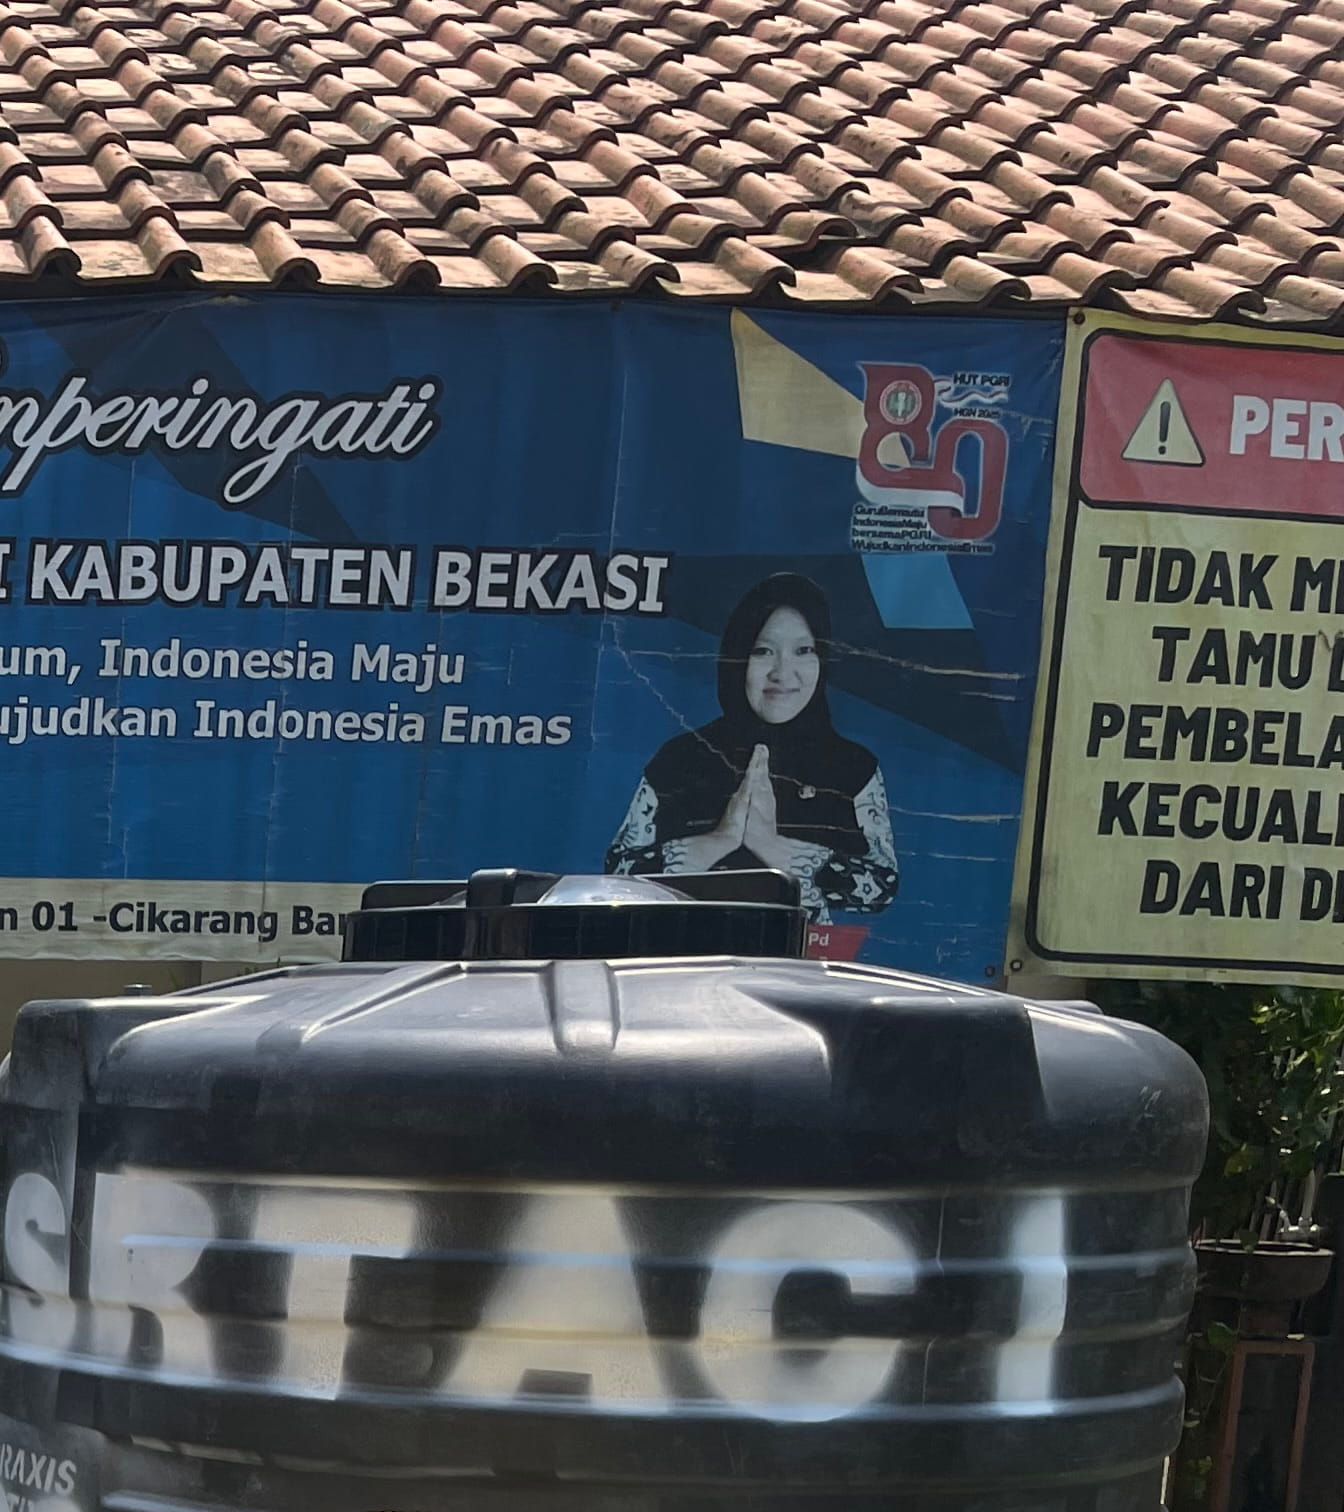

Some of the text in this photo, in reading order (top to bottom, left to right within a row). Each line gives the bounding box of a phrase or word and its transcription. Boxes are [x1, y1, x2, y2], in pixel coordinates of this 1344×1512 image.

[30, 543, 412, 607] KABUPATEN
[434, 551, 669, 613] BEKASI
[1098, 544, 1279, 611] TIDAK
[98, 638, 333, 681] Indonesia
[351, 643, 465, 692] Maju
[1151, 626, 1316, 690] TAMU
[194, 700, 424, 743] Indonesia
[441, 705, 572, 745] Emas
[31, 901, 78, 933] 01
[1139, 859, 1285, 920] DARI
